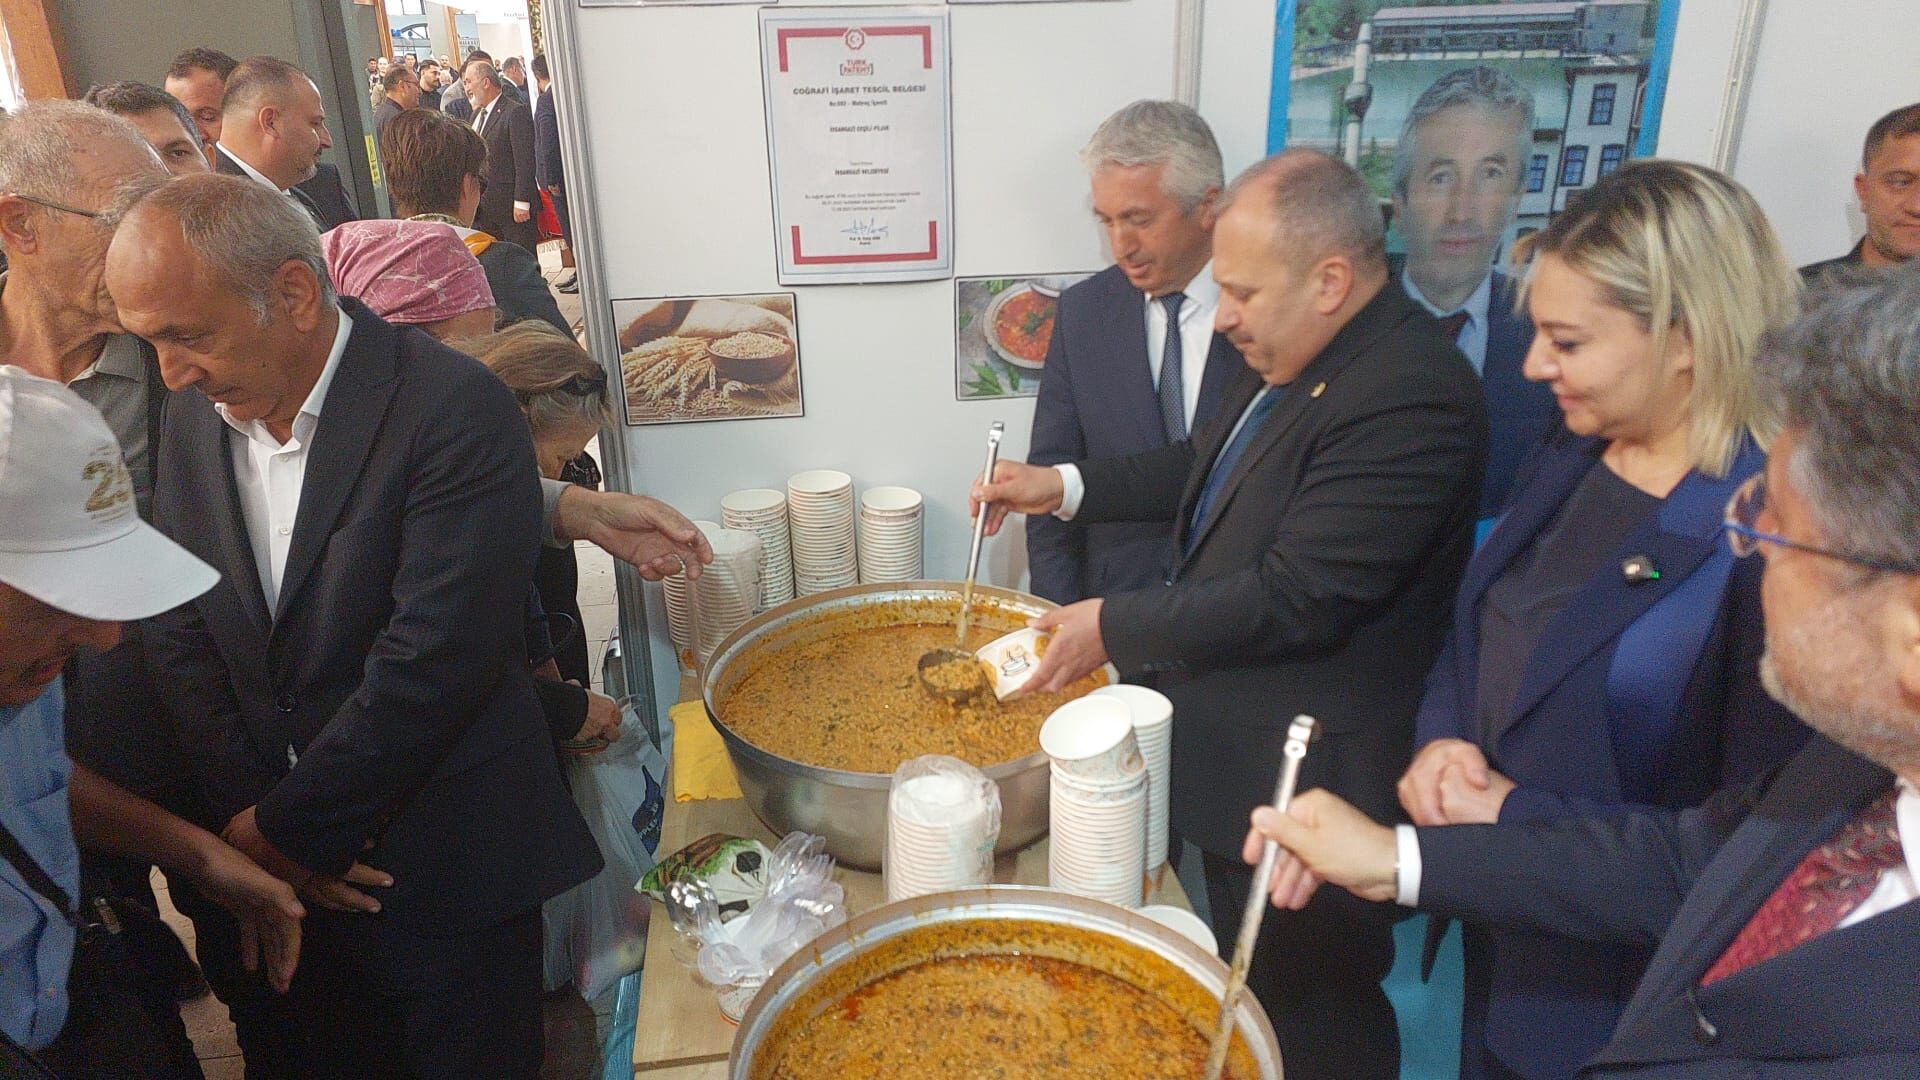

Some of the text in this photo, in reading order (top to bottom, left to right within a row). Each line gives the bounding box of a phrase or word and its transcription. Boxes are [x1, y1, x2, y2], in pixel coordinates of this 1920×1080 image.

[792, 84, 926, 95] COĞRAFİ İŞARET TESCİL BELGESİ
